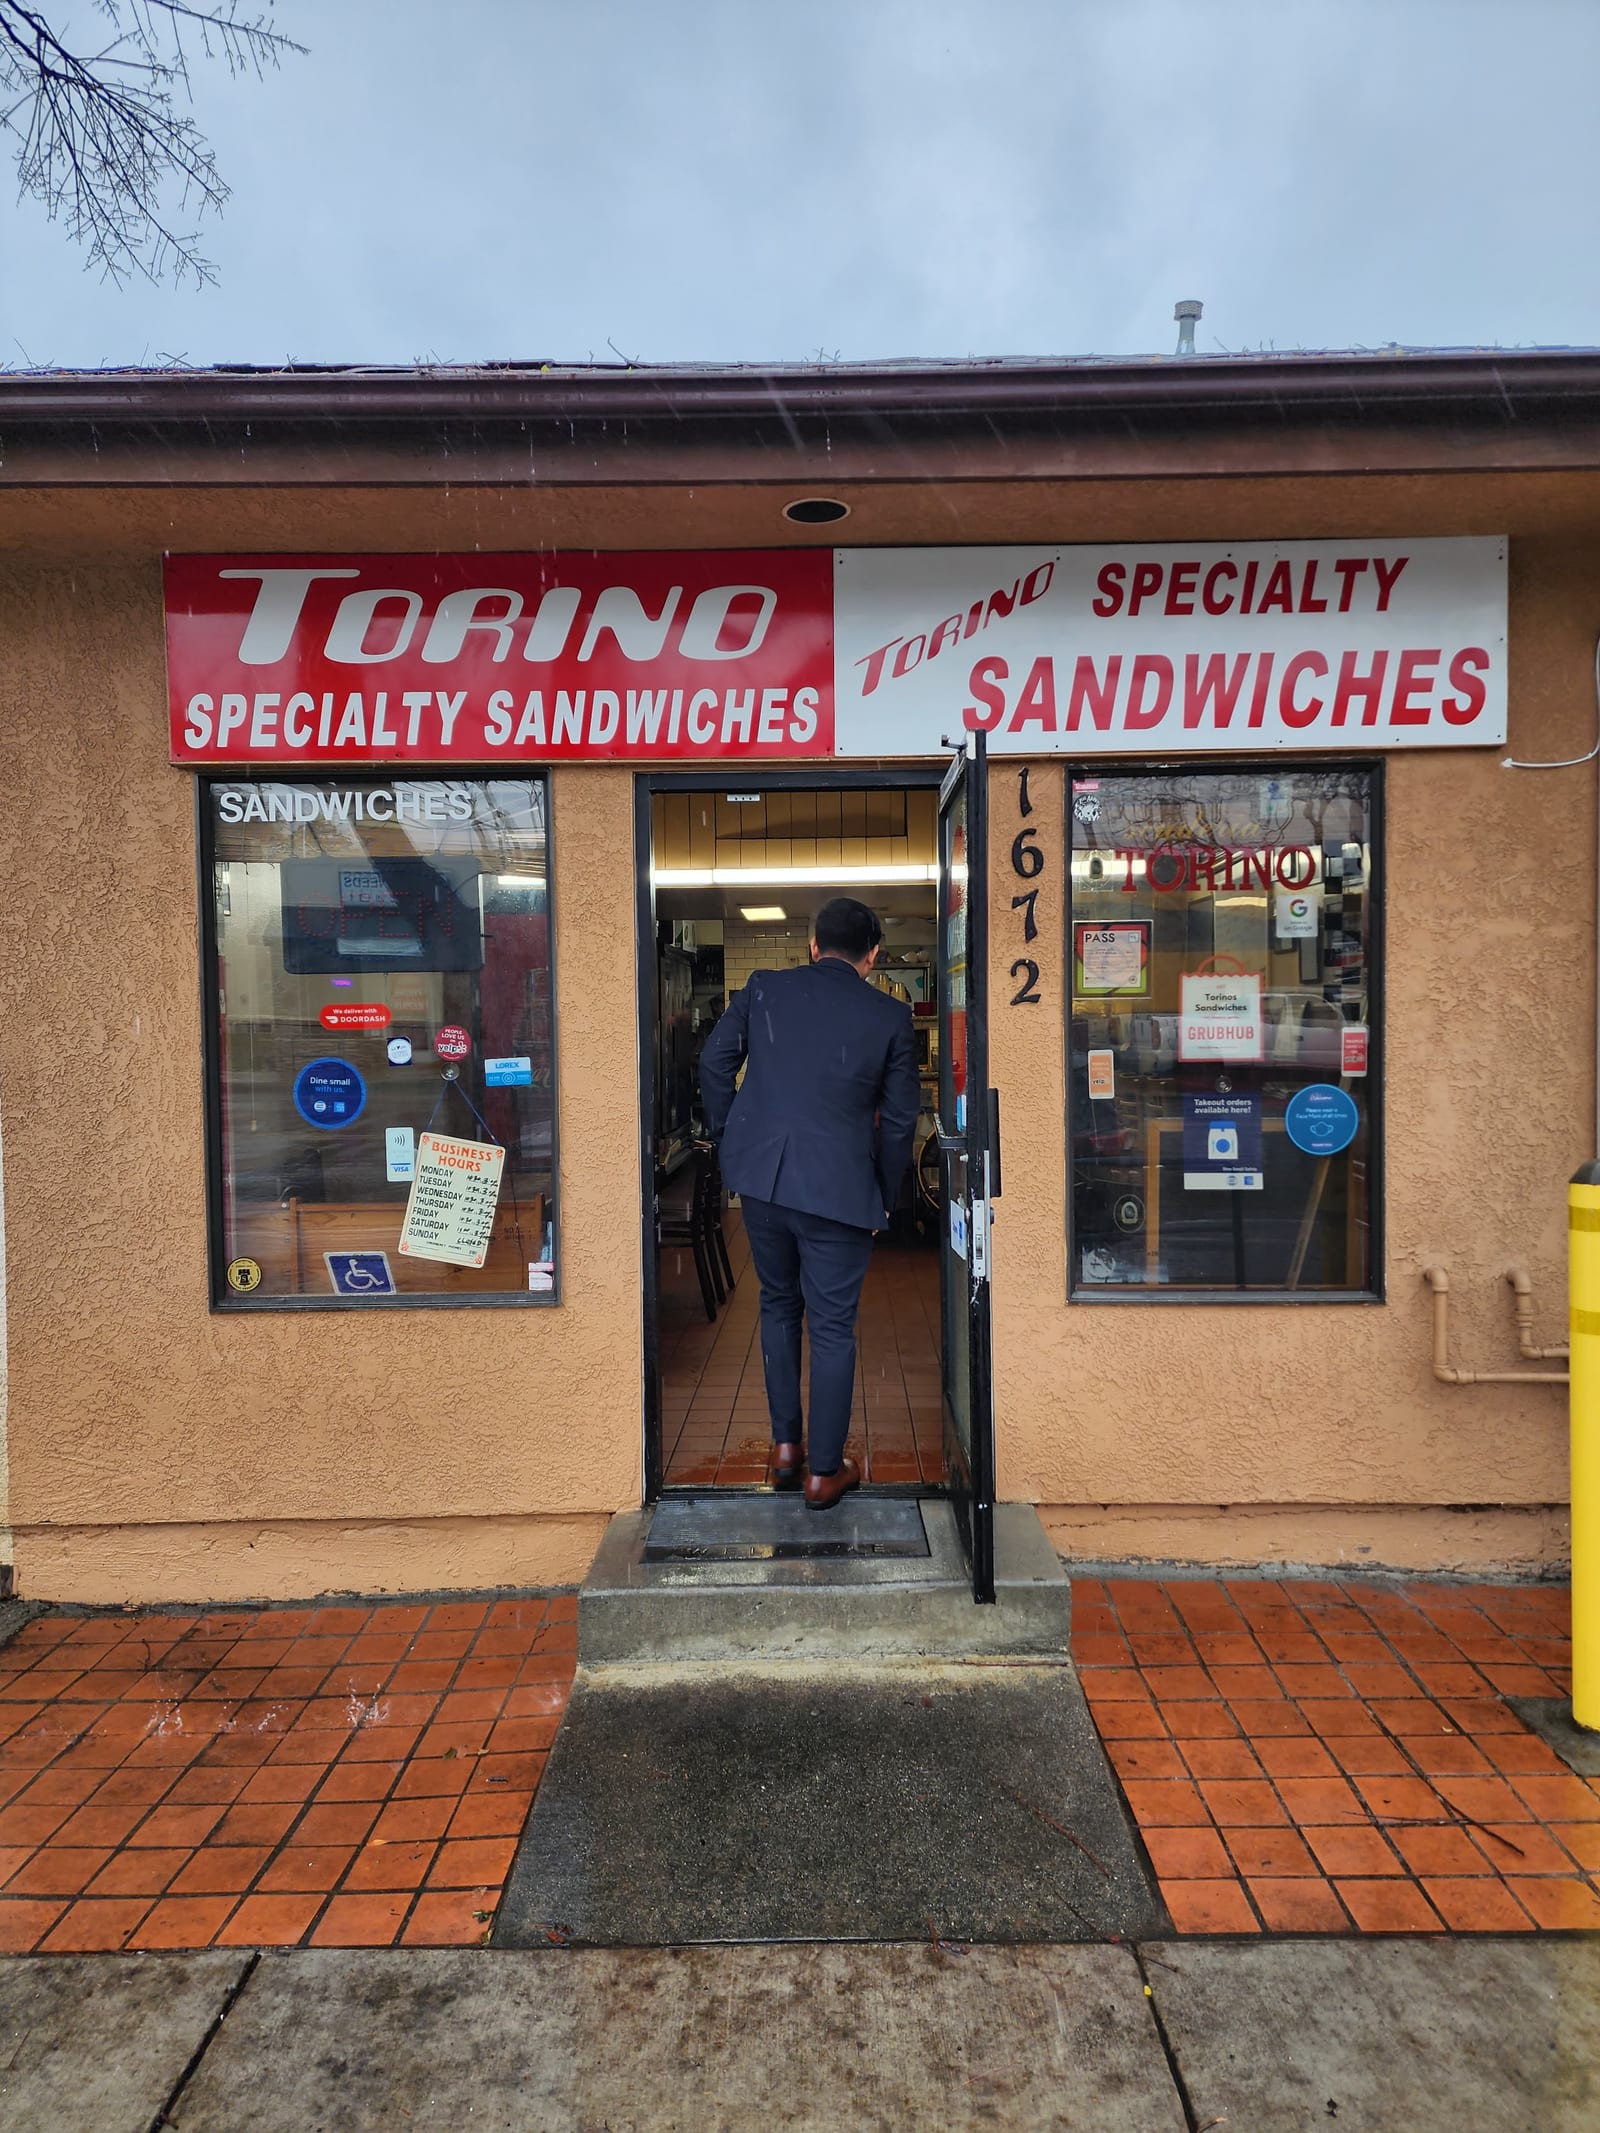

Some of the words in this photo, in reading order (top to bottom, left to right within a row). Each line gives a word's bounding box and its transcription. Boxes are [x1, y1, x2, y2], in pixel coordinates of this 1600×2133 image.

[1092, 557, 1409, 618] SPECIALTY
[218, 568, 777, 664] TORINO
[962, 647, 1490, 732] SANDWICHES
[184, 691, 467, 748] SPECIALTY
[484, 687, 819, 745] SANDWICHES
[219, 789, 473, 823] SANDWICHES
[1115, 844, 1317, 892] TORINO
[297, 892, 454, 938] OPEN
[1085, 933, 1116, 943] PASS
[1204, 993, 1238, 1001] Torinos
[1195, 1003, 1248, 1012] Sandwiches
[441, 1032, 456, 1040] LOVE
[1188, 1026, 1254, 1040] GRUBHUB
[495, 1061, 520, 1069] LOREX
[310, 1077, 328, 1085] Dine
[329, 1078, 351, 1086] small
[1194, 1098, 1225, 1106] Takeout
[1226, 1098, 1252, 1106] orders
[1194, 1106, 1228, 1114] available
[1230, 1106, 1251, 1114] here!
[438, 1155, 481, 1172] HOURS
[420, 1165, 454, 1178] MONDAY
[420, 1175, 452, 1188] TUESDAY
[417, 1185, 463, 1201] WEDNESDAY
[415, 1196, 454, 1211] THURSDAY
[412, 1206, 439, 1218] FRIDAY
[410, 1217, 449, 1231] SATURDAY
[408, 1228, 439, 1240] SUNDAY
